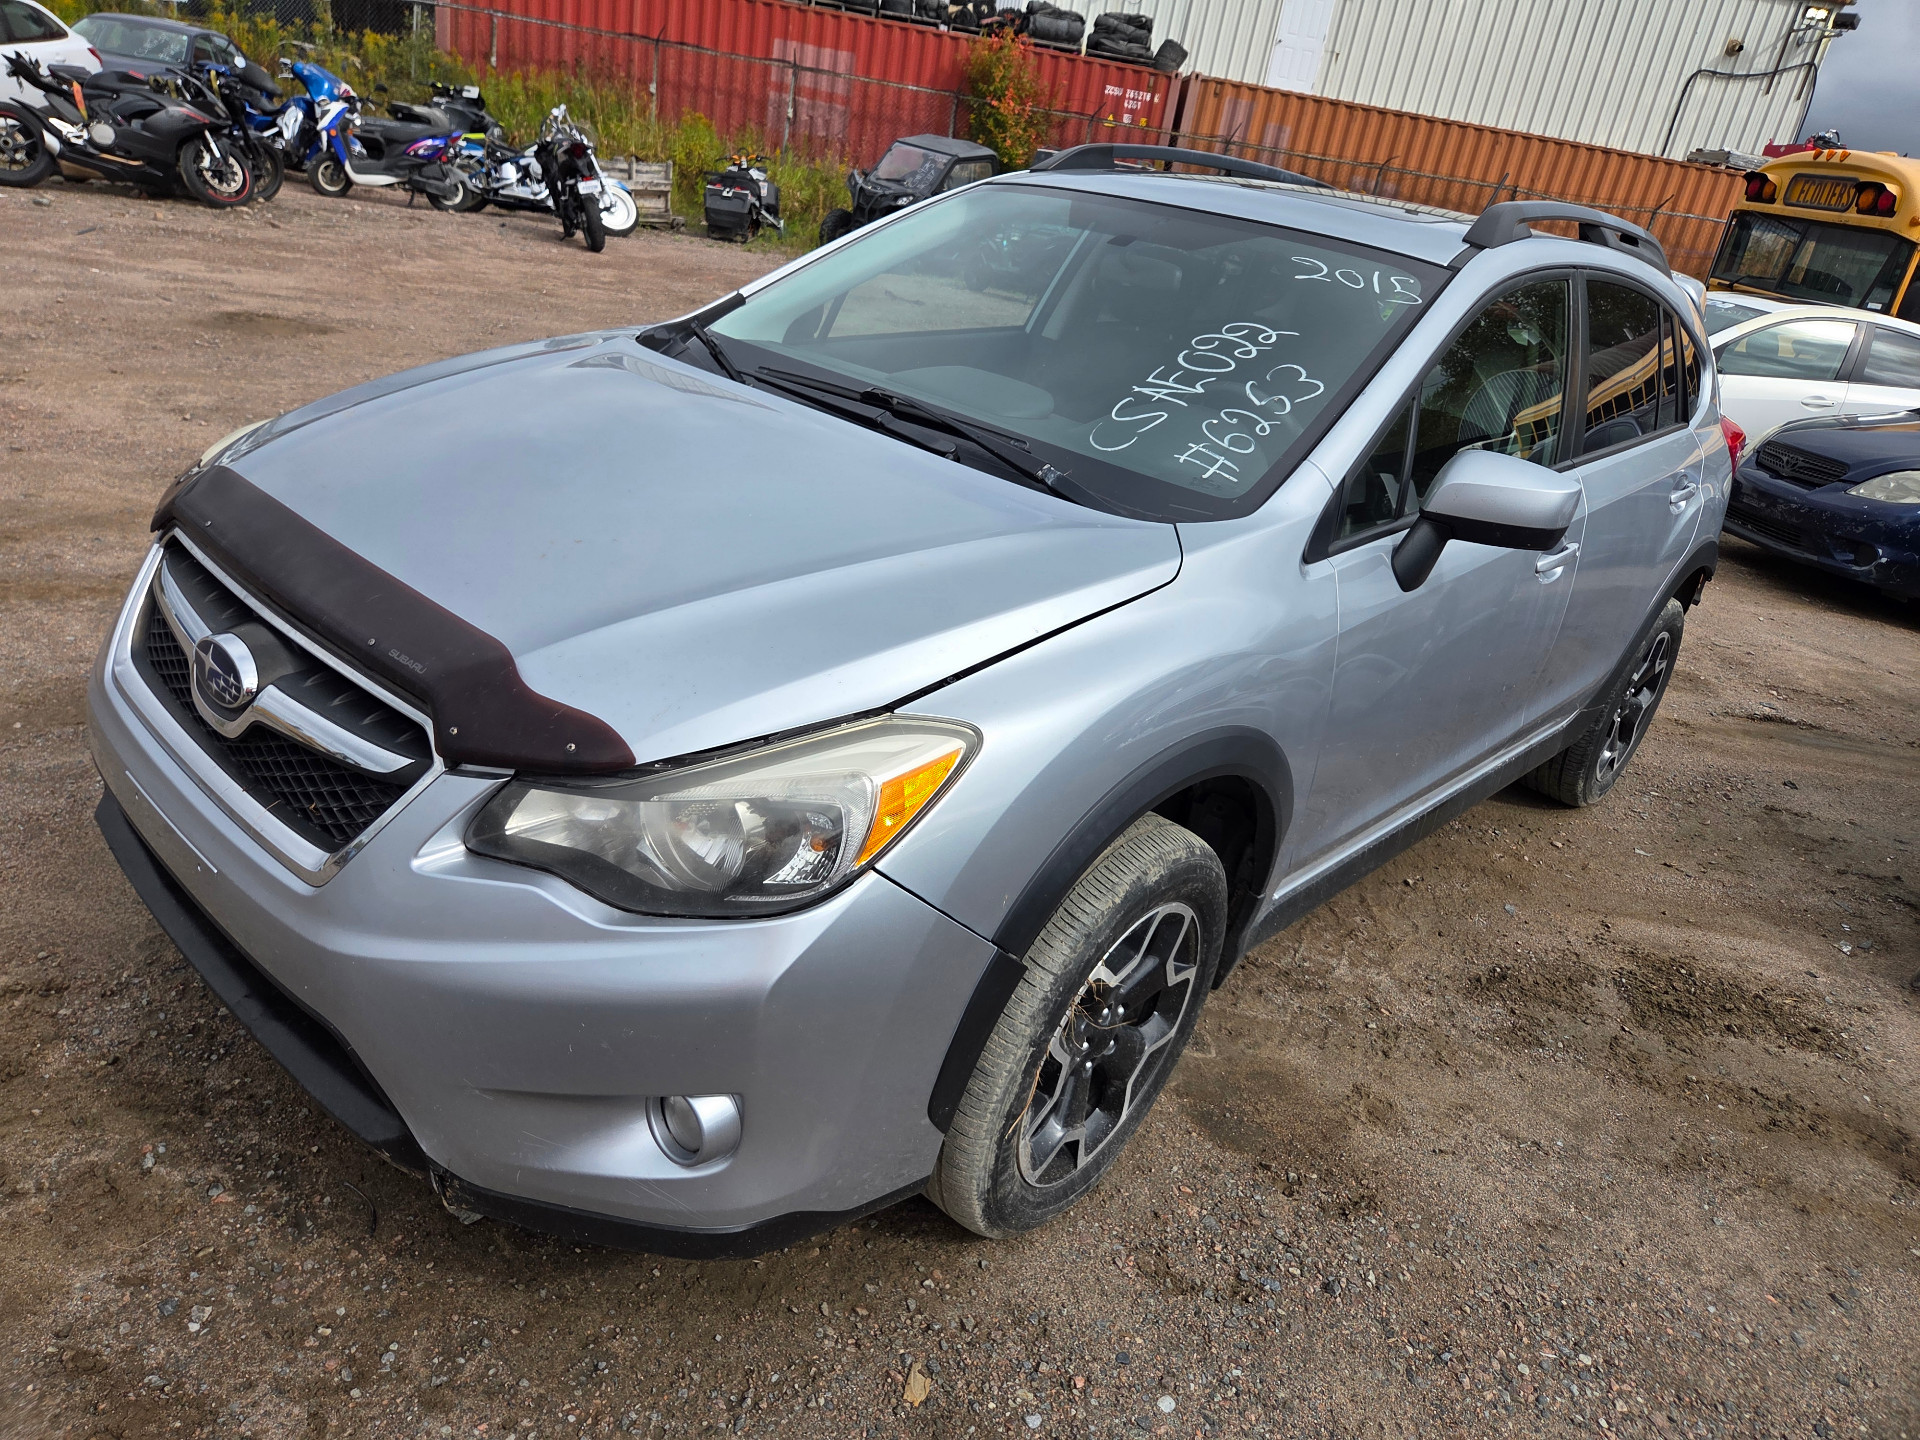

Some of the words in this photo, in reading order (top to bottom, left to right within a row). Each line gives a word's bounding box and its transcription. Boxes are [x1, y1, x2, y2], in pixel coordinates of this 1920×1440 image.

[1797, 179, 1858, 207] ECOLIERS
[1291, 256, 1423, 305] 2015
[1174, 364, 1325, 483] #6253
[388, 648, 428, 675] SUBARU
